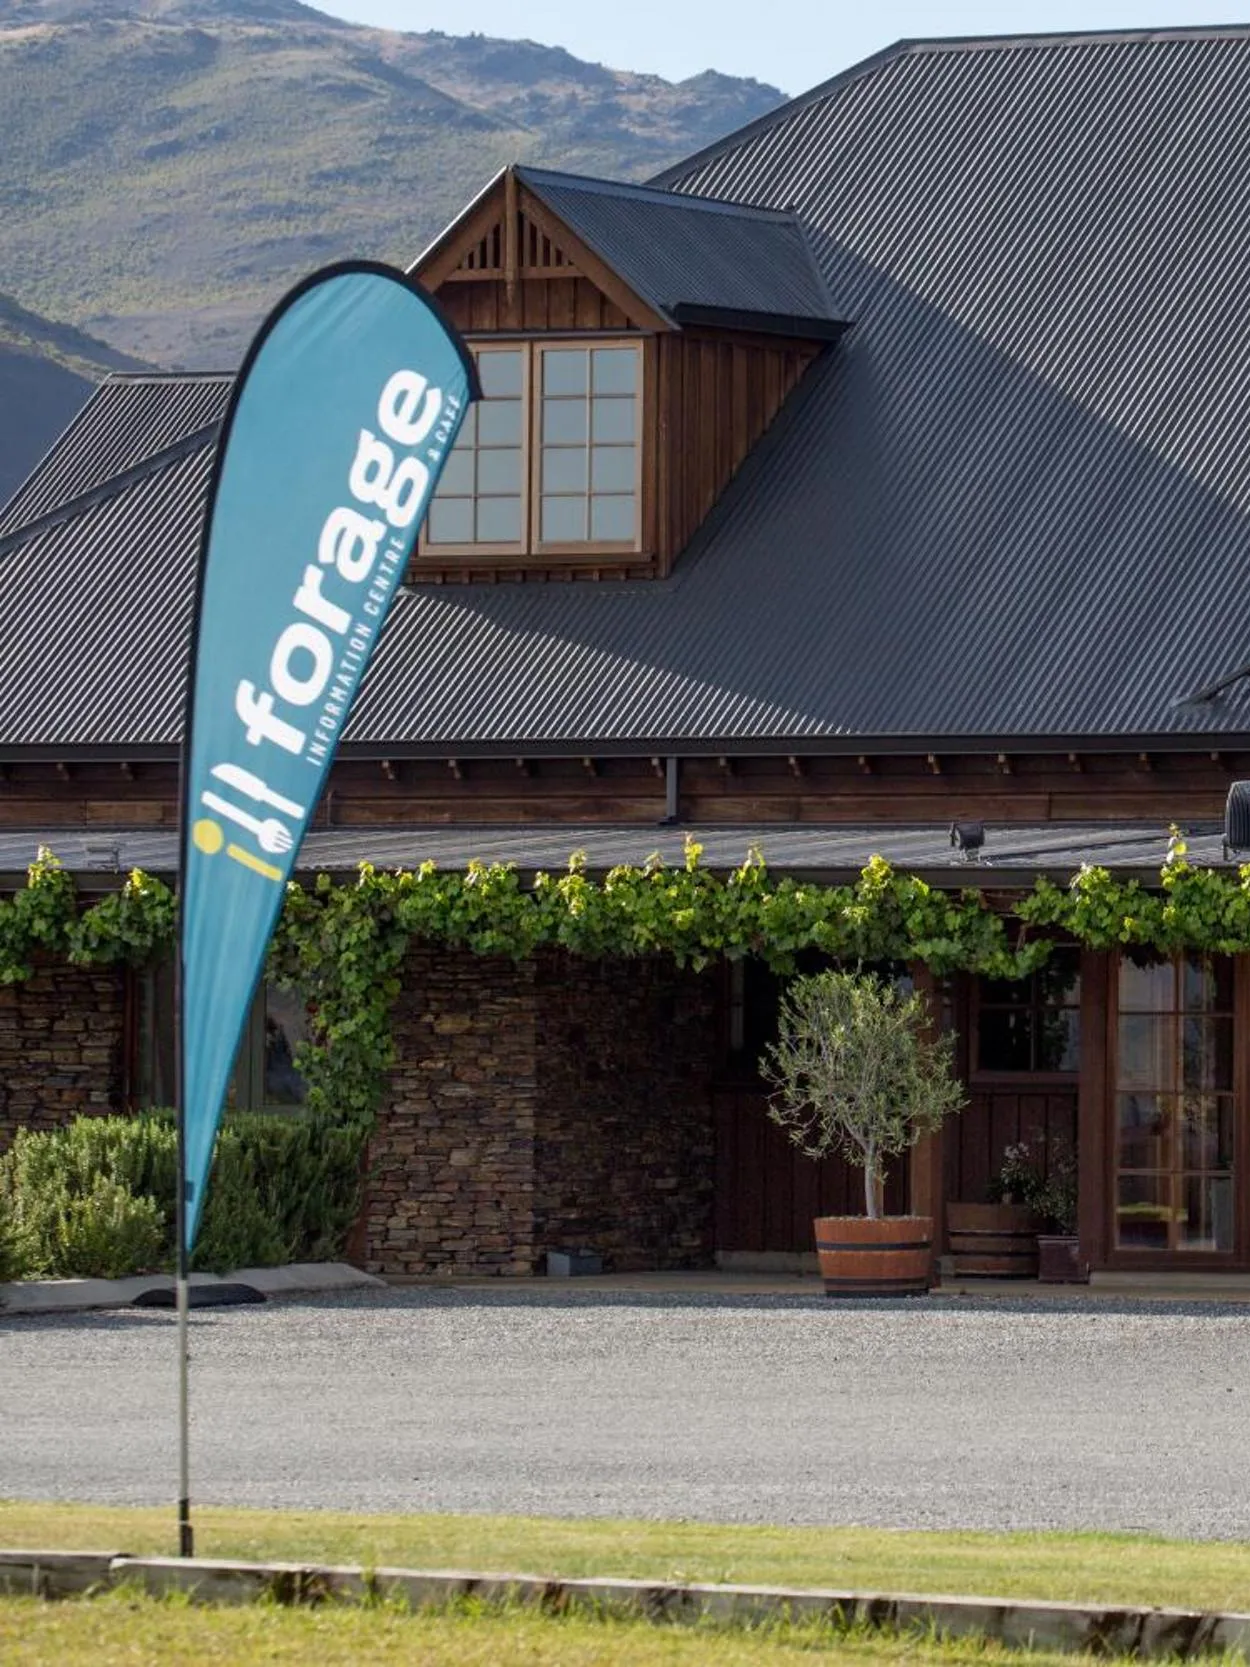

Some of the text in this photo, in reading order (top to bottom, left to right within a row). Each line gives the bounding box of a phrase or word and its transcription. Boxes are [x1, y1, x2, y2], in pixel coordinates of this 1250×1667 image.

[235, 368, 442, 756] forage
[306, 623, 373, 767] INFORMATION
[363, 536, 406, 617] CENTRE
